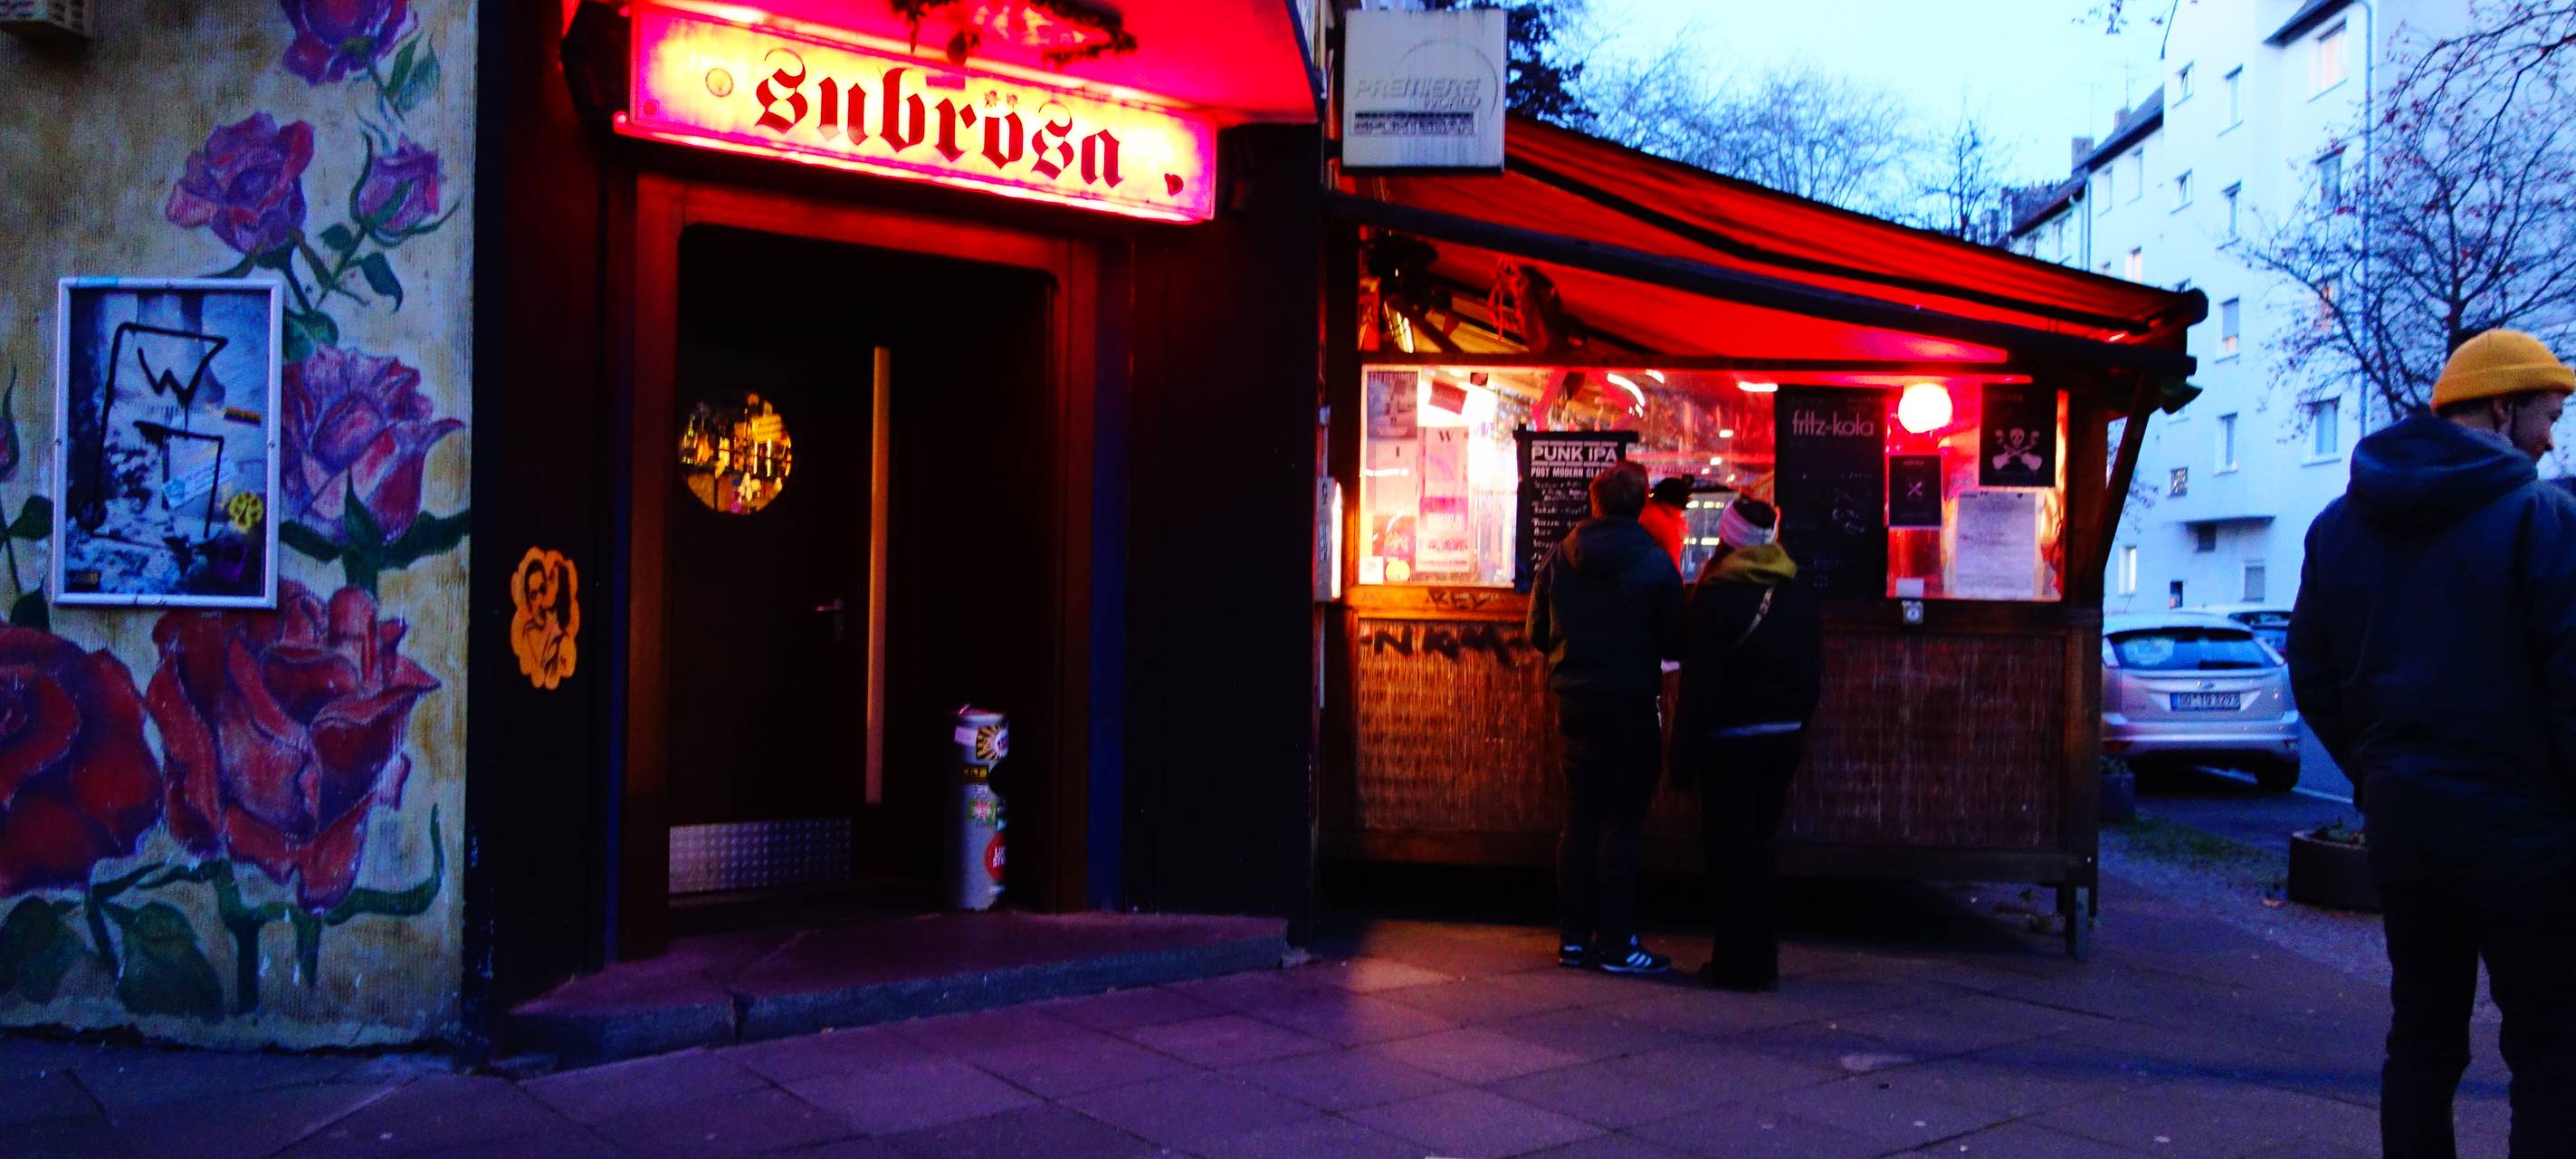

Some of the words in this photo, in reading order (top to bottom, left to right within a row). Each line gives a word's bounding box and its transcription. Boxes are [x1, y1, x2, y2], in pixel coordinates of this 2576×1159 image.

[1356, 78, 1481, 98] PREMIERE
[1792, 410, 1874, 436] fritz-kola
[1531, 446, 1583, 461] PUNK
[1589, 446, 1617, 463] IPA
[1531, 466, 1550, 477] POST
[1552, 466, 1583, 478] MODERN
